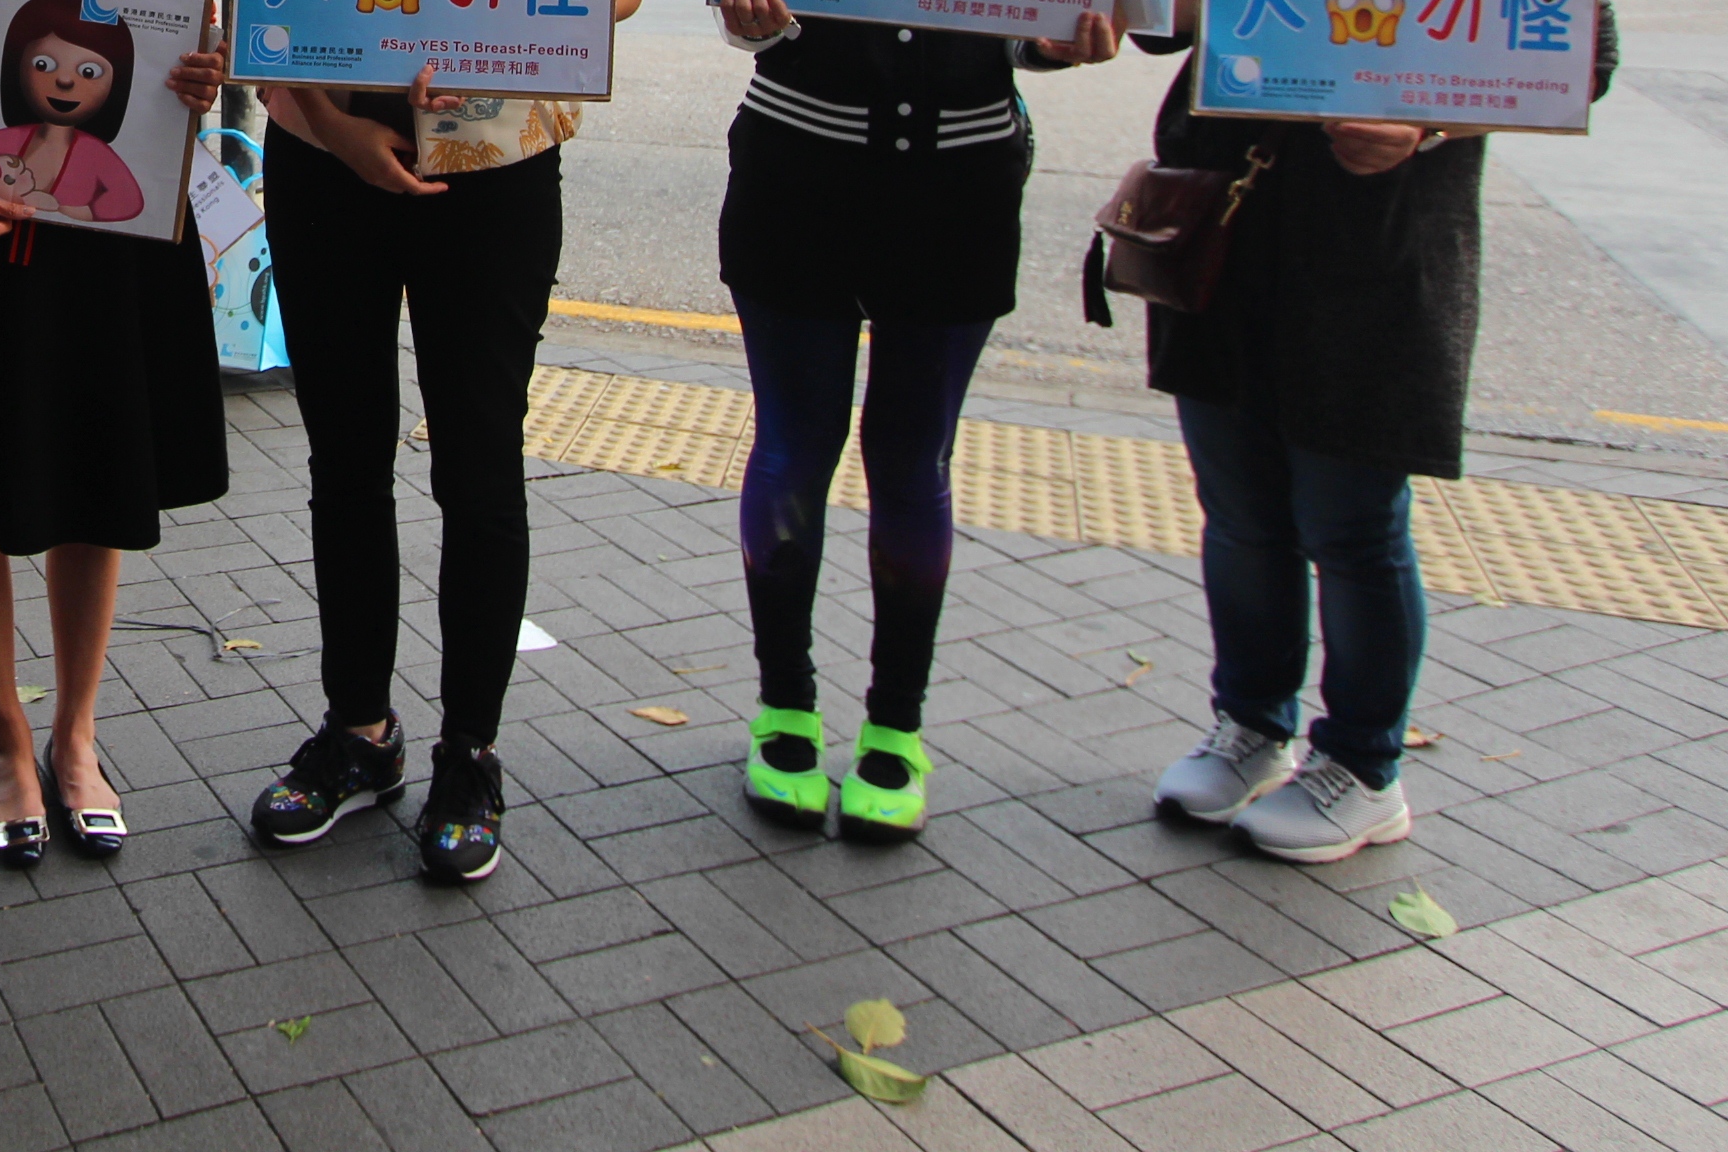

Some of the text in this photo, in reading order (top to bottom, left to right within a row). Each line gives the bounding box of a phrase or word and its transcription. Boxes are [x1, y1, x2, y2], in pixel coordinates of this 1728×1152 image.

[380, 39, 589, 59] #Say YES To Breast-Feeding
[1395, 72, 1425, 84] YES
[1429, 74, 1446, 86] To
